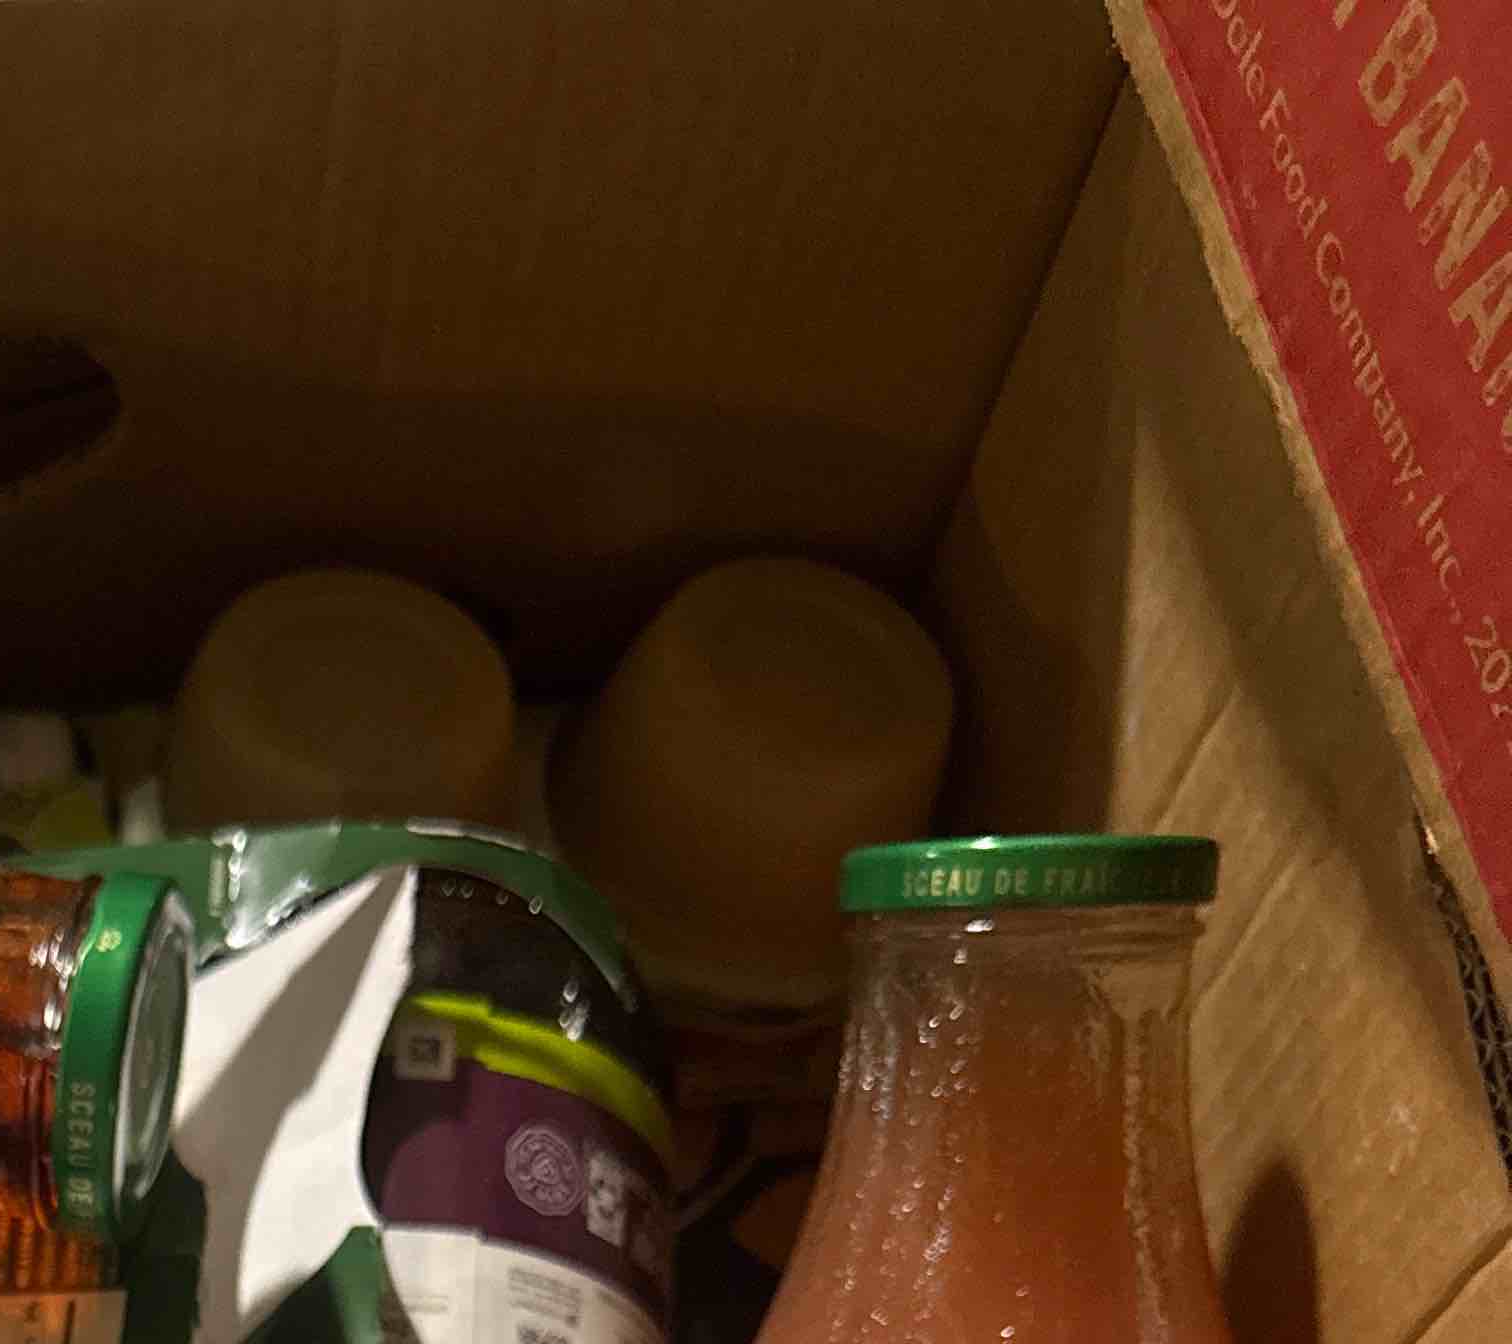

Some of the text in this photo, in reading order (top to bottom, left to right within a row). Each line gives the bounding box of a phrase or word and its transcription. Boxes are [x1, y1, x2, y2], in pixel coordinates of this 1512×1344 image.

[1259, 88, 1328, 240] Food
[1315, 230, 1424, 503] Company,
[1356, 0, 1512, 452] BANA
[994, 867, 1029, 897] DE
